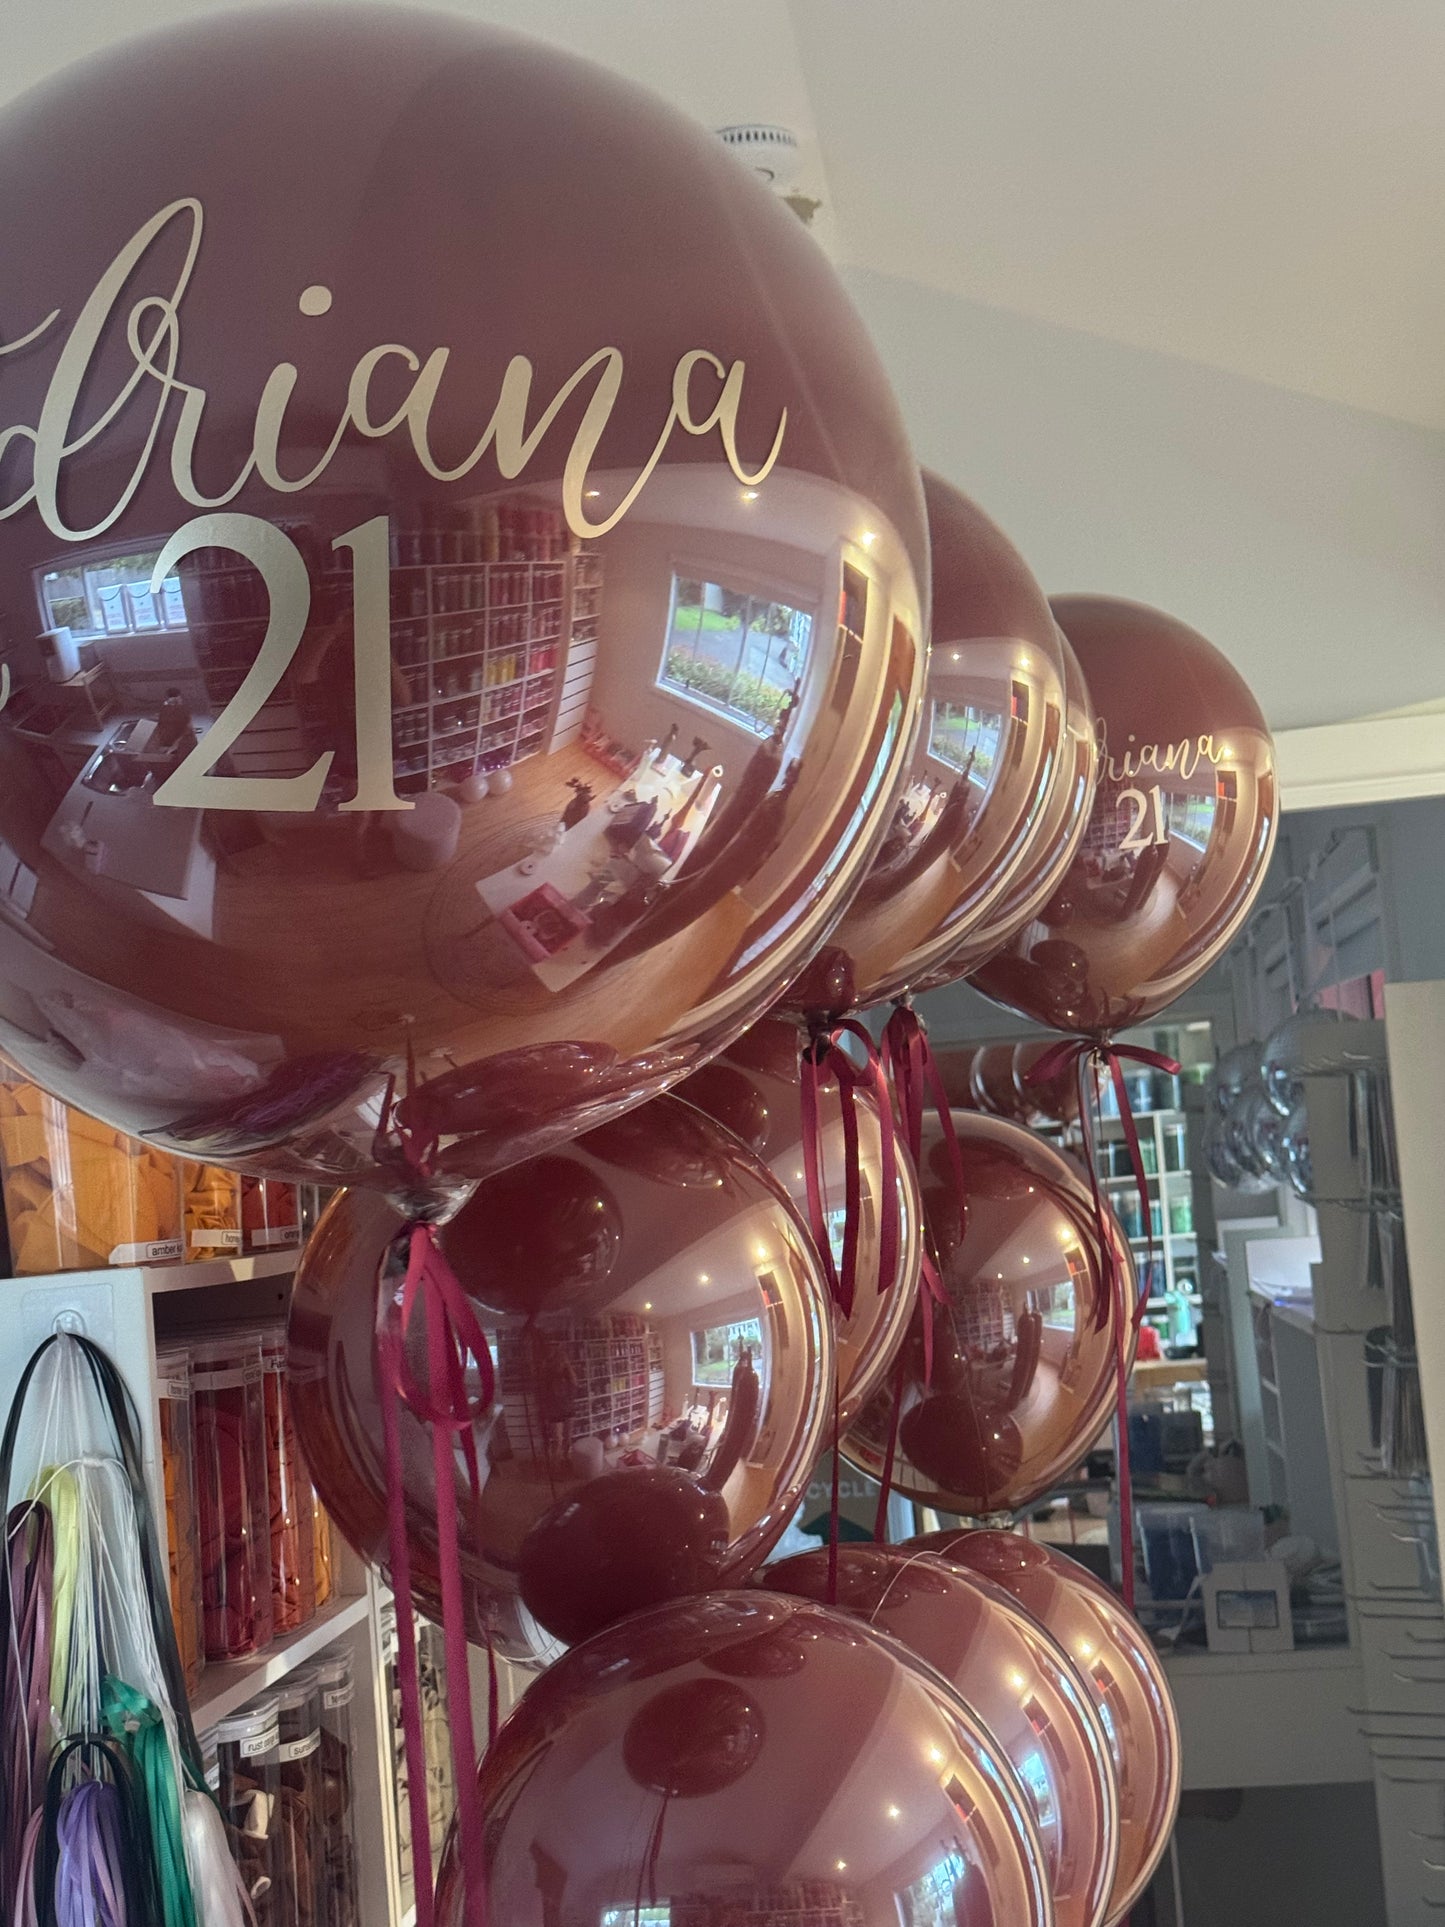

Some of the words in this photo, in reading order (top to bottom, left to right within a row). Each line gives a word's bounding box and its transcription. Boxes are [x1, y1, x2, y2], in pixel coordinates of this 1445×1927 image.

[0, 197, 788, 541] driana
[152, 513, 416, 813] 21
[1115, 784, 1169, 850] 21
